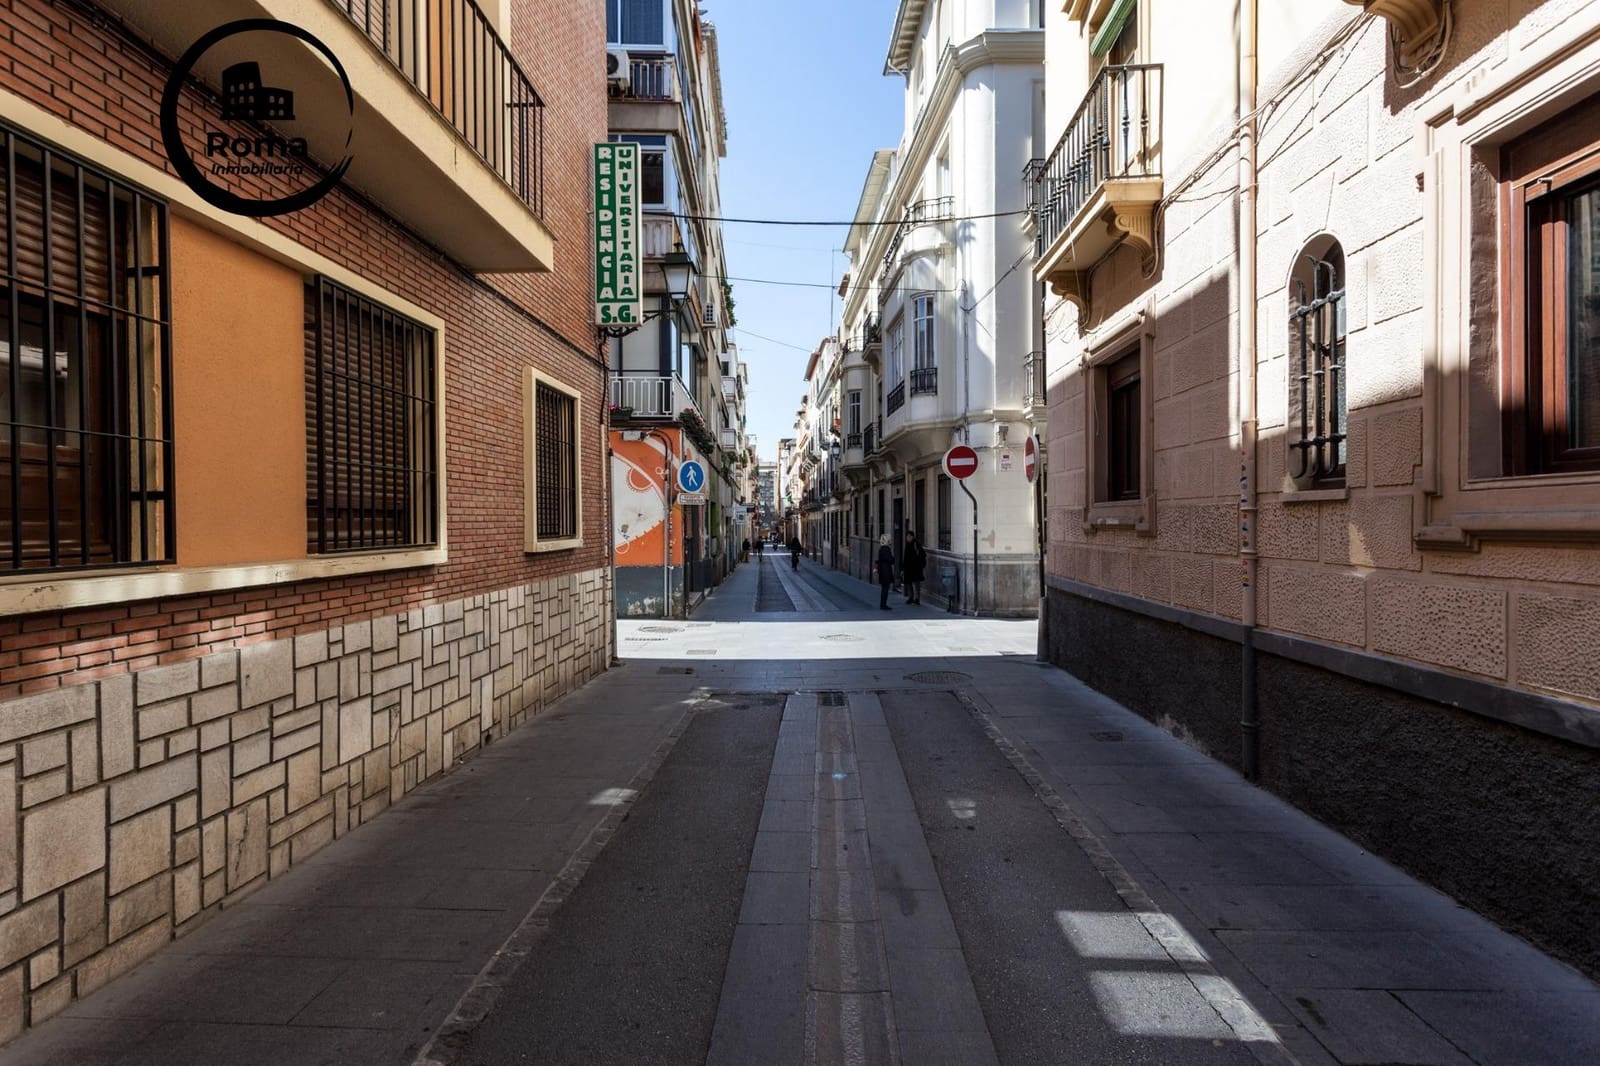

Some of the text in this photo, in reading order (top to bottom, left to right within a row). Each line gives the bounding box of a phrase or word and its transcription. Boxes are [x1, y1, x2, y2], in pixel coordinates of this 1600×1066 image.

[598, 147, 615, 299] RESIDENCIA
[618, 149, 634, 297] UNIVERSITARIA
[601, 304, 637, 323] S.G.
